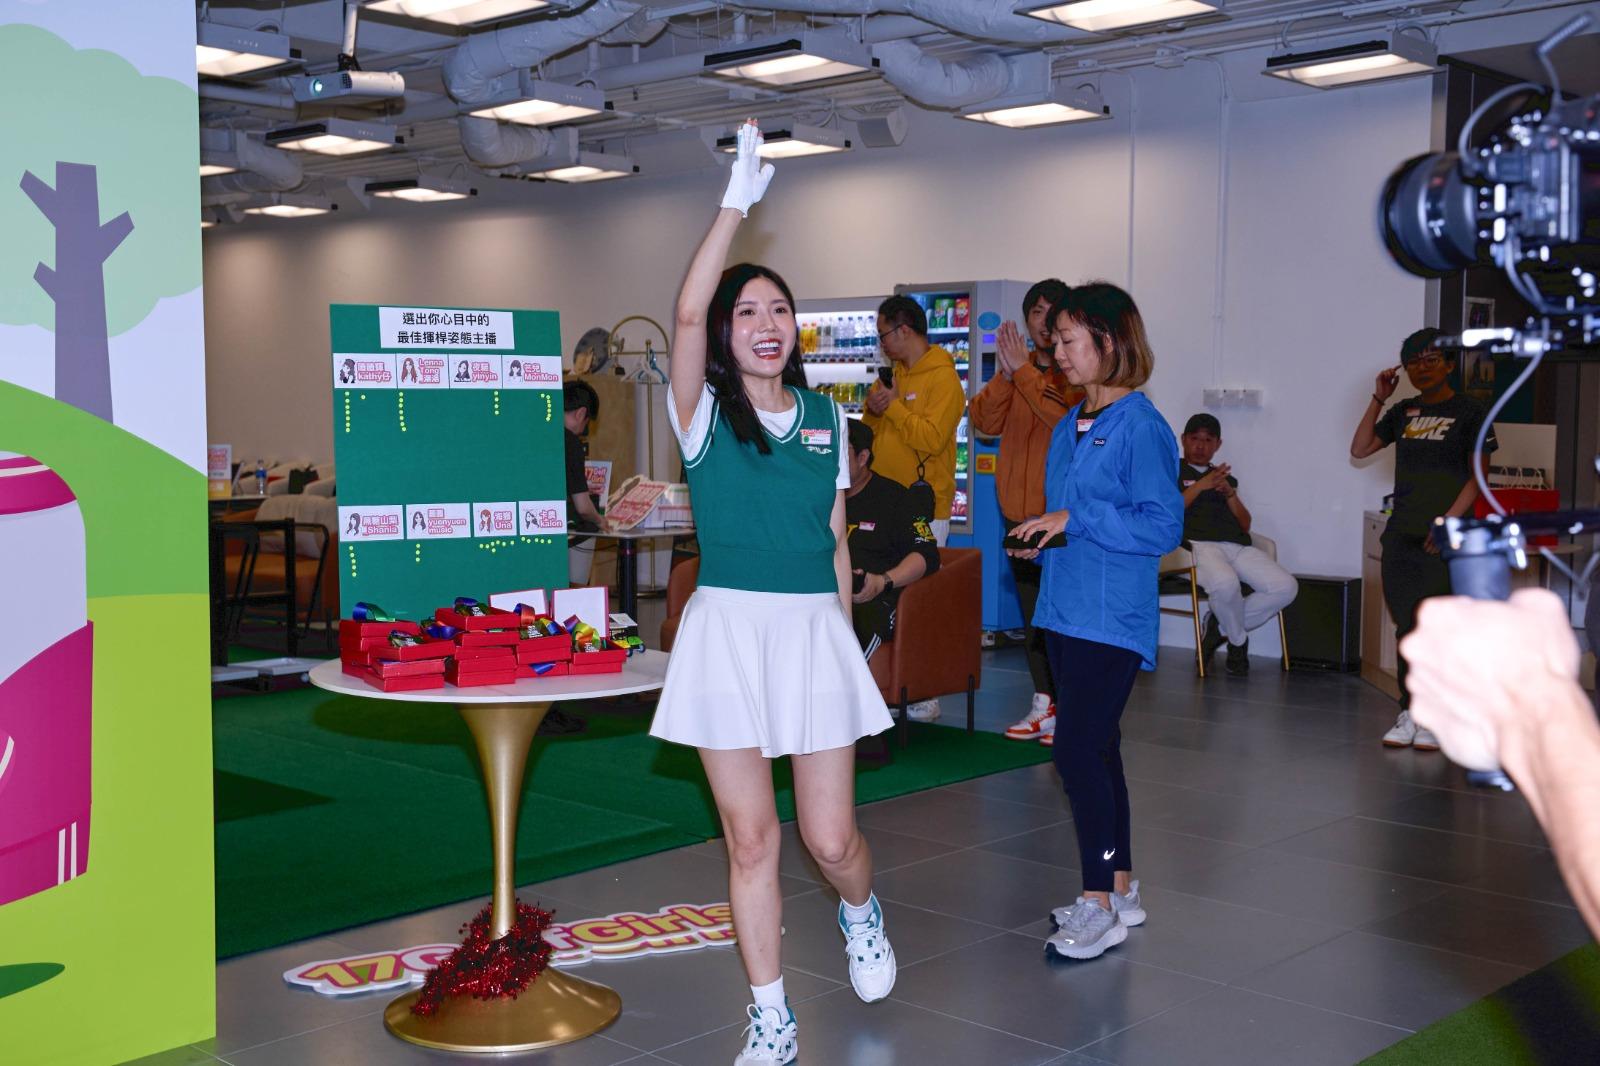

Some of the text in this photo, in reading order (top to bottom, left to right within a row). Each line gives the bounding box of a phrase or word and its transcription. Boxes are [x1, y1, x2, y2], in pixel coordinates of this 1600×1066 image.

[402, 312, 490, 327] 選出你心目中的
[397, 331, 497, 345] 最佳揮桿姿態主播
[495, 521, 512, 530] Una
